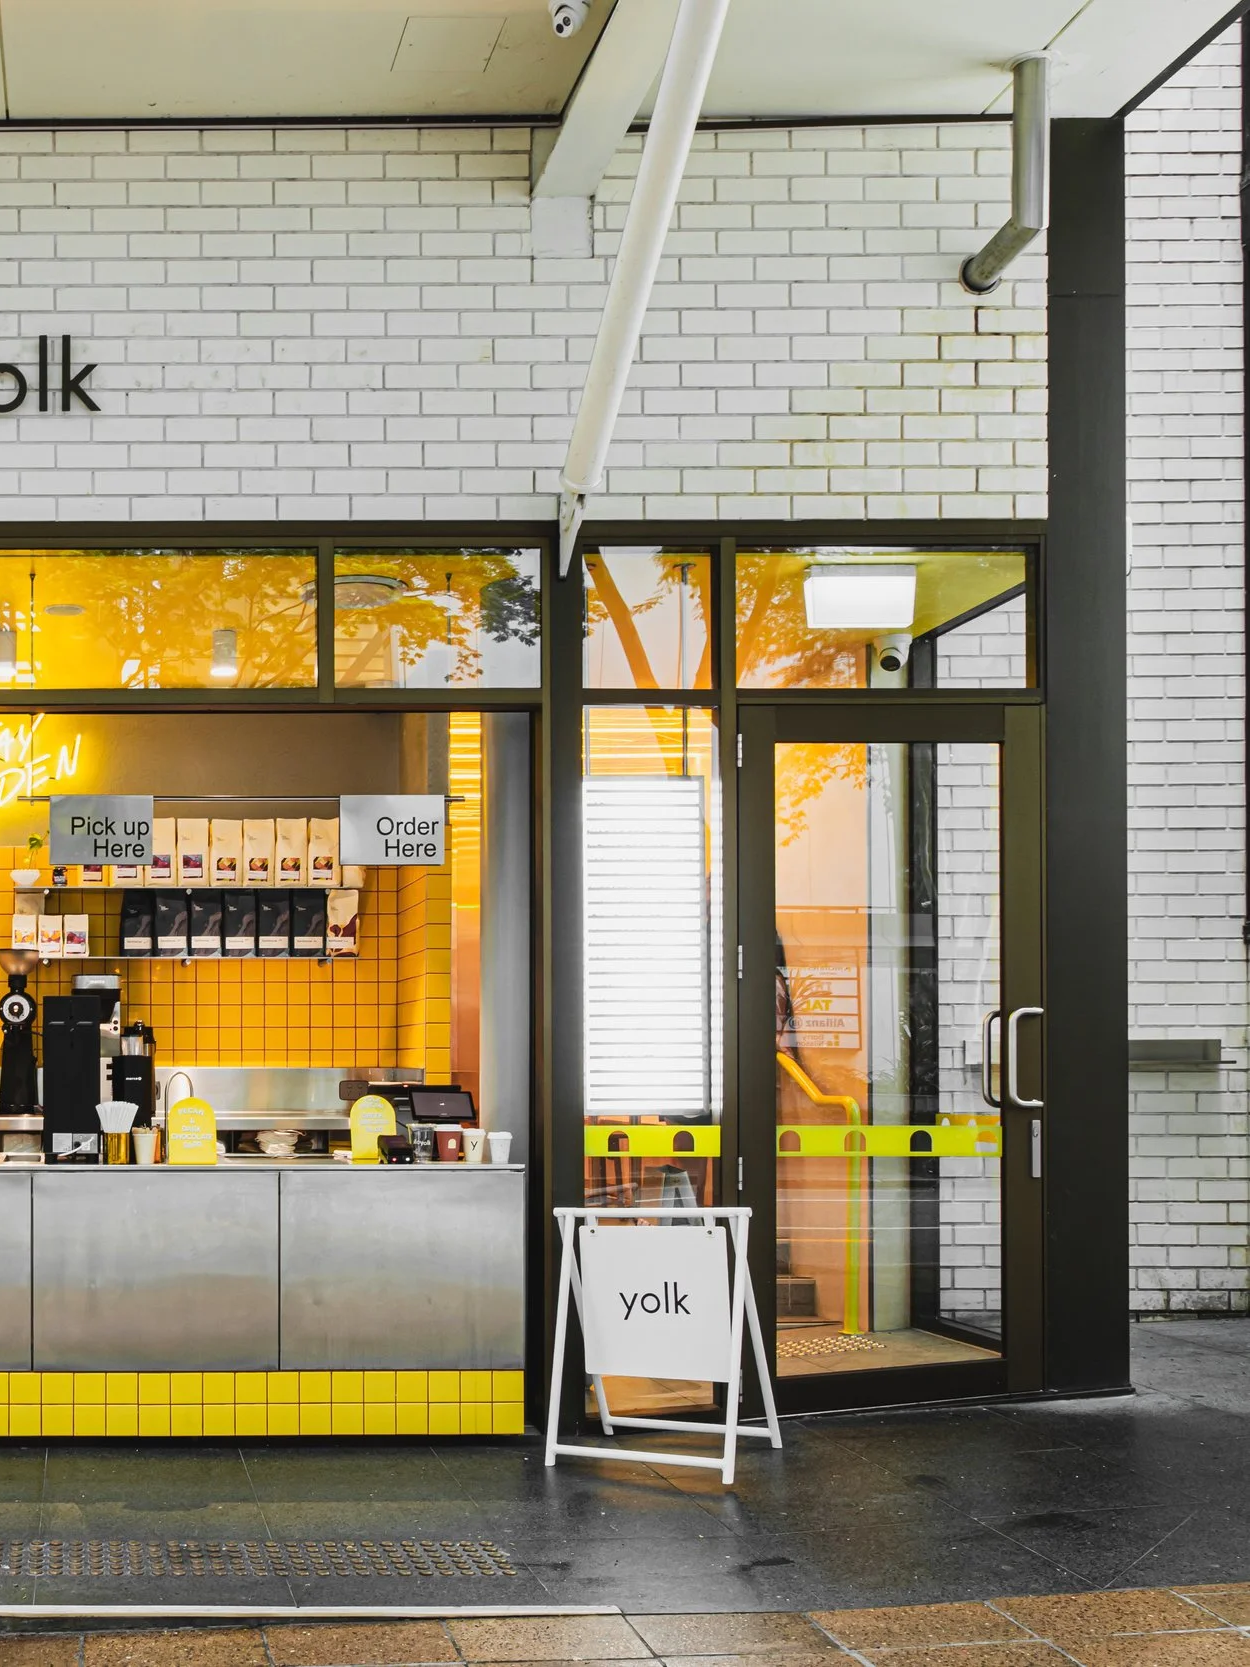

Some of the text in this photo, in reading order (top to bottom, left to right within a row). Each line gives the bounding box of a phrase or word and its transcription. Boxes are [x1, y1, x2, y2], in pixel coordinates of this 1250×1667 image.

[71, 816, 150, 841] Pick up
[376, 816, 440, 836] Order
[93, 838, 145, 858] Here
[384, 838, 437, 858] Here
[618, 1281, 692, 1320] yolk
